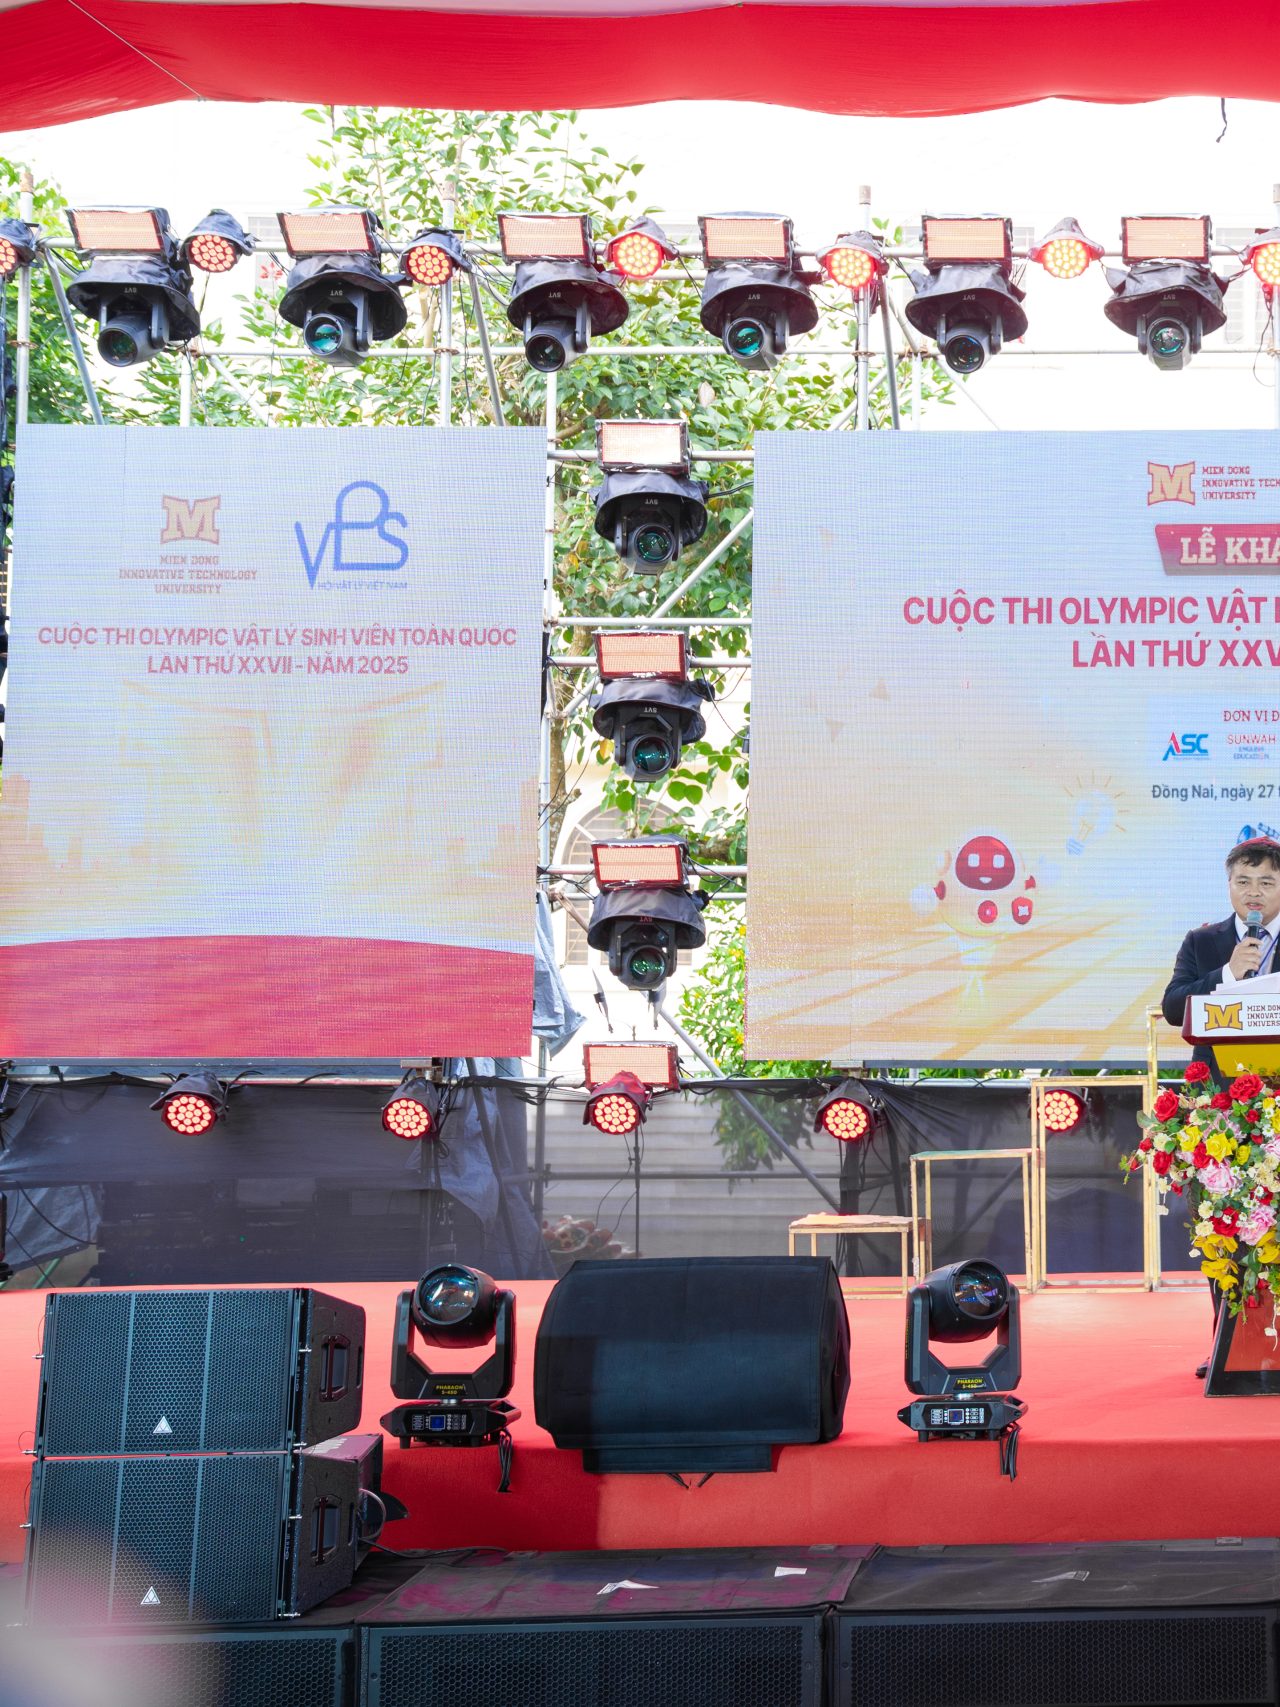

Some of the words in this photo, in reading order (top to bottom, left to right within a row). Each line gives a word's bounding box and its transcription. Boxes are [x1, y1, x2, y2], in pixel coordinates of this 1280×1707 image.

[1202, 466, 1224, 475] MIEN
[1228, 466, 1250, 475] DONG
[1147, 461, 1196, 506] M
[1202, 479, 1255, 488] INNOVATIVE
[1202, 491, 1257, 500] UNIVERSITY
[160, 495, 221, 545] M
[1179, 526, 1217, 565] LỄ
[160, 554, 188, 566] MIEN
[191, 554, 220, 566] DONG
[119, 568, 185, 580] INNOVATIVE
[187, 568, 258, 580] TECHNOLOGY
[155, 583, 222, 594] UNIVERSITY
[903, 588, 995, 632] CUỘC
[1002, 597, 1053, 624] THI
[1059, 596, 1199, 624] OLYMPIC
[1206, 588, 1268, 632] VẬT
[38, 621, 97, 649] CUỘC
[103, 627, 135, 645] THI
[139, 627, 228, 646] OLYMPIC
[233, 622, 271, 650] VẬT
[274, 622, 297, 646] LÝ
[301, 628, 346, 646] SINH
[351, 622, 395, 646] VIÊN
[400, 623, 454, 646] TOÀN
[458, 621, 517, 647] QUỐC
[1072, 631, 1135, 668] LẦN
[1142, 631, 1211, 667] THỨ
[193, 650, 235, 674] THỨ
[238, 655, 292, 673] XXVII
[307, 650, 354, 674] NĂM
[357, 655, 409, 674] 2025
[1223, 709, 1250, 722] ĐƠN
[1256, 710, 1268, 726] VỊ
[1162, 731, 1209, 761] ASC
[1227, 734, 1276, 745] SUNWAH
[1152, 784, 1188, 802] Đồng
[1191, 785, 1217, 801] Nai,
[1221, 785, 1254, 802] ngày
[1258, 785, 1274, 798] 27
[1204, 1001, 1243, 1031] M
[1247, 1004, 1265, 1012] MIEN
